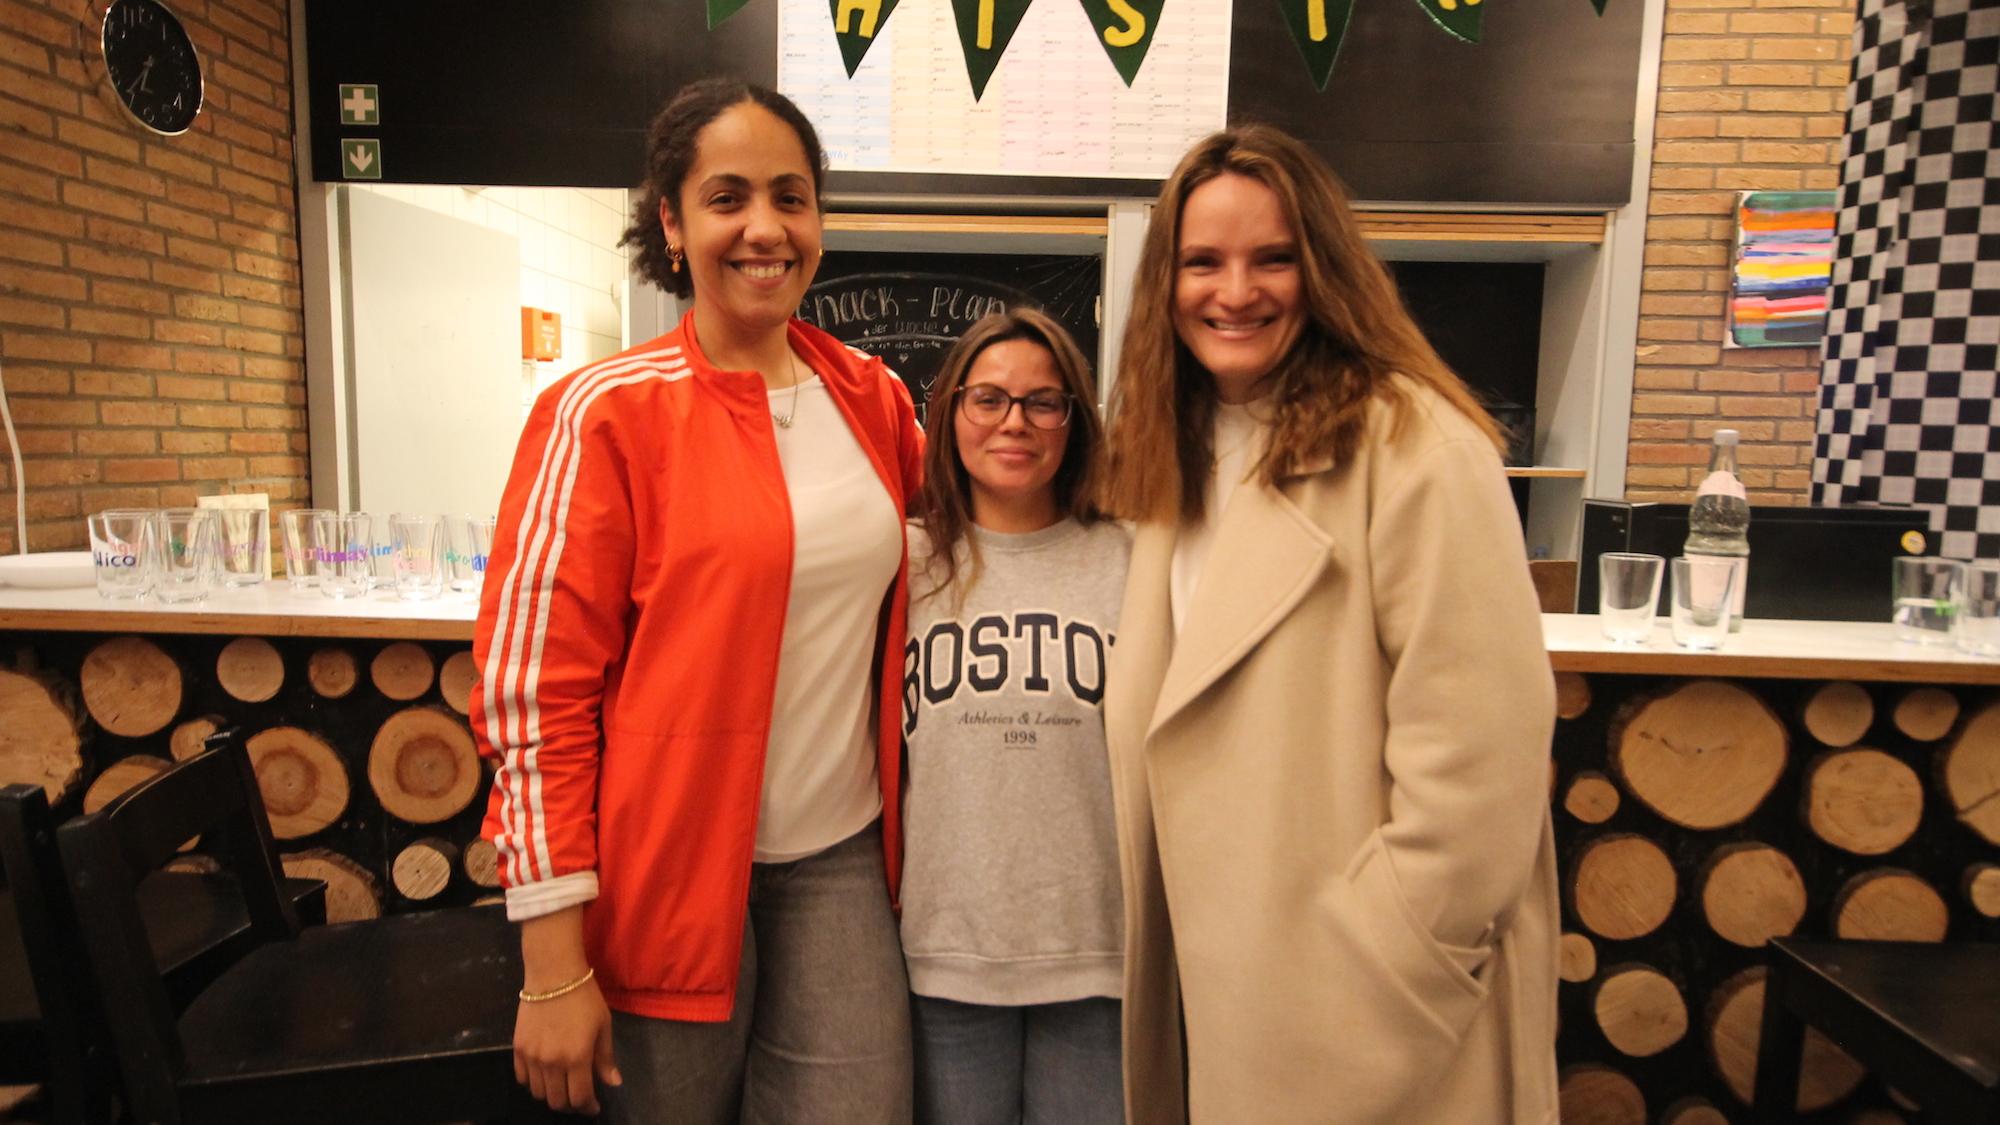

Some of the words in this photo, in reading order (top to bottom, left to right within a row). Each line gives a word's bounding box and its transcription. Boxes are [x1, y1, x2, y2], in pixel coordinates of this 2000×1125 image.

[902, 612, 1117, 738] BOSTO
[958, 711, 1014, 725] Athletics
[1017, 712, 1029, 725] &
[1034, 711, 1082, 726] Leisure
[1003, 730, 1037, 744] 1998
